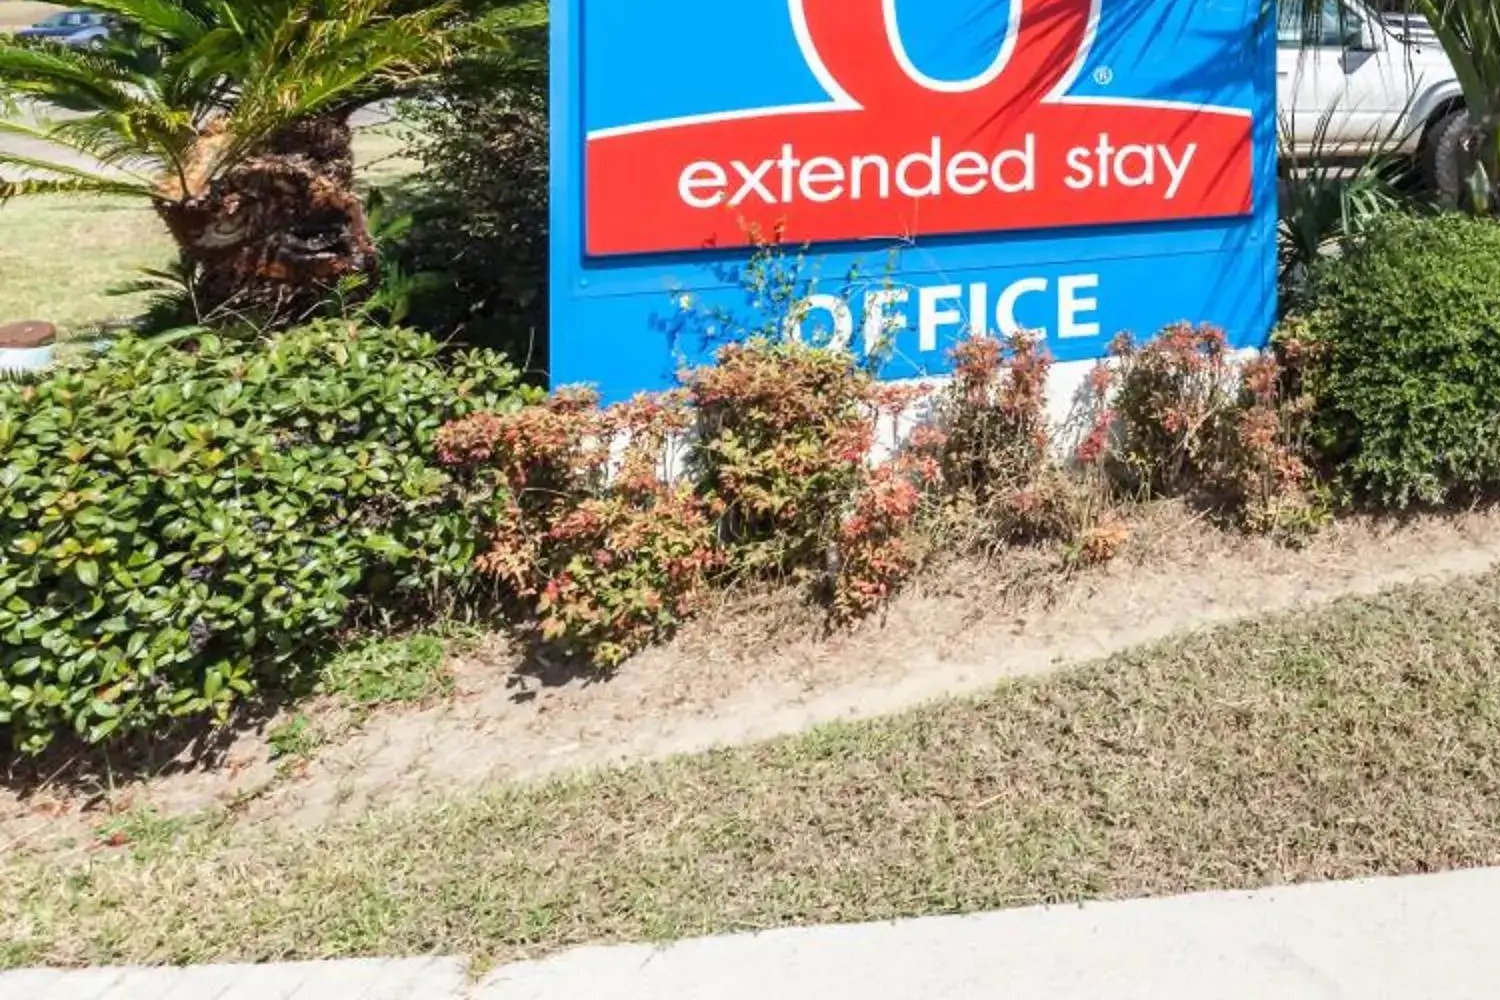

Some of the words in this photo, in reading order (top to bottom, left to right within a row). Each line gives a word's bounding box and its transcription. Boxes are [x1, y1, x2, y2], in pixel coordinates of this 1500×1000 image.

[677, 132, 1036, 208] extended
[1063, 132, 1197, 199] stay
[784, 273, 1100, 353] OFFICE
